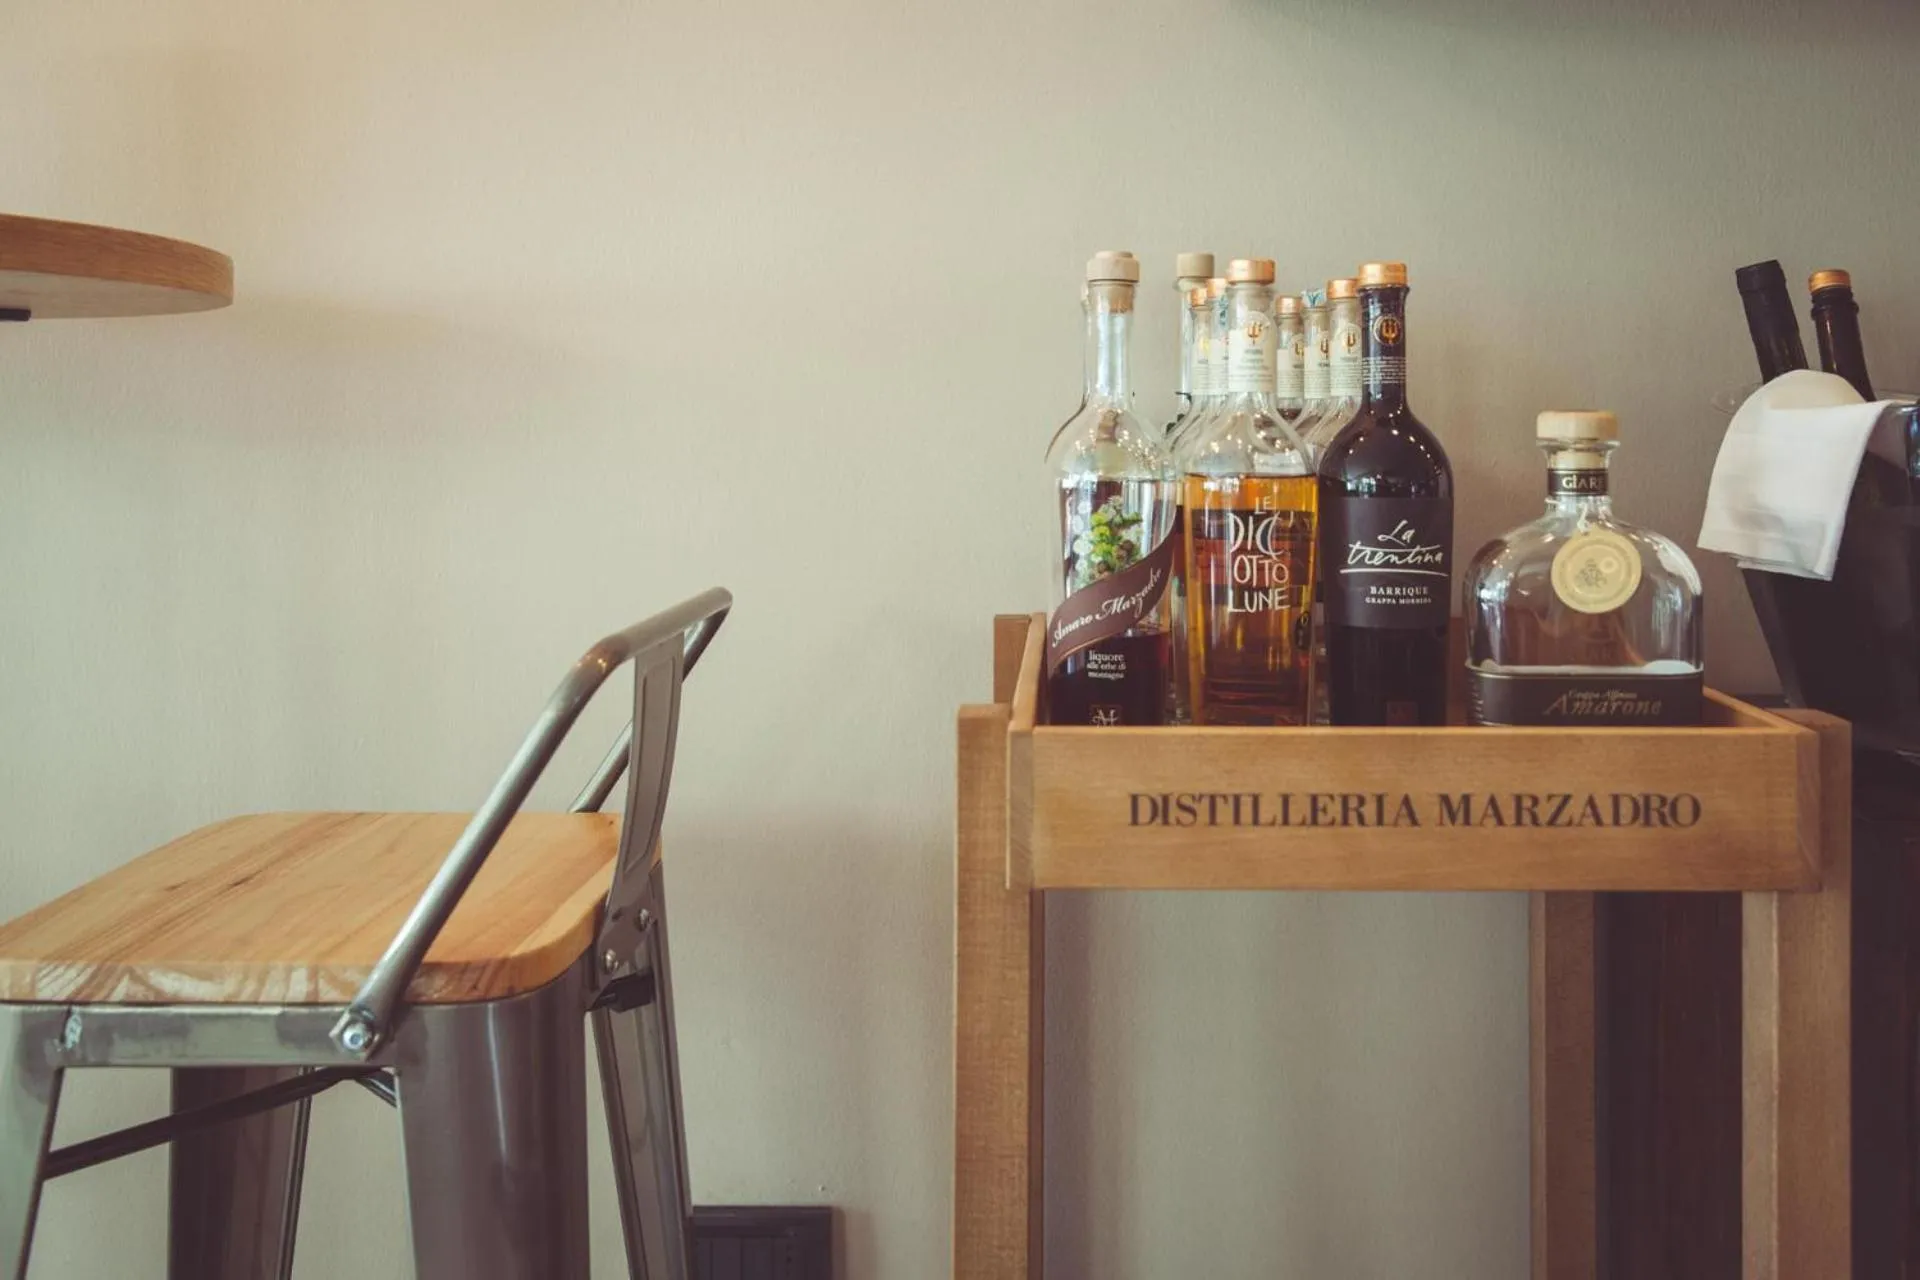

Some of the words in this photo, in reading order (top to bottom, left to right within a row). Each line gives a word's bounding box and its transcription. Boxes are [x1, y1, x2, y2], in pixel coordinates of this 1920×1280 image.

[1254, 496, 1272, 515] LE
[1377, 520, 1415, 546] La
[1348, 541, 1443, 565] trentina
[1233, 554, 1289, 588] OTTO
[1229, 587, 1290, 612] LUNE
[1370, 586, 1429, 596] BARRIQUE
[1052, 614, 1093, 648] Amaro
[1088, 650, 1125, 664] liquore
[1542, 693, 1662, 715] Amarone
[1128, 792, 1421, 828] DISTILLERIA
[1437, 792, 1702, 829] MARZADRO
